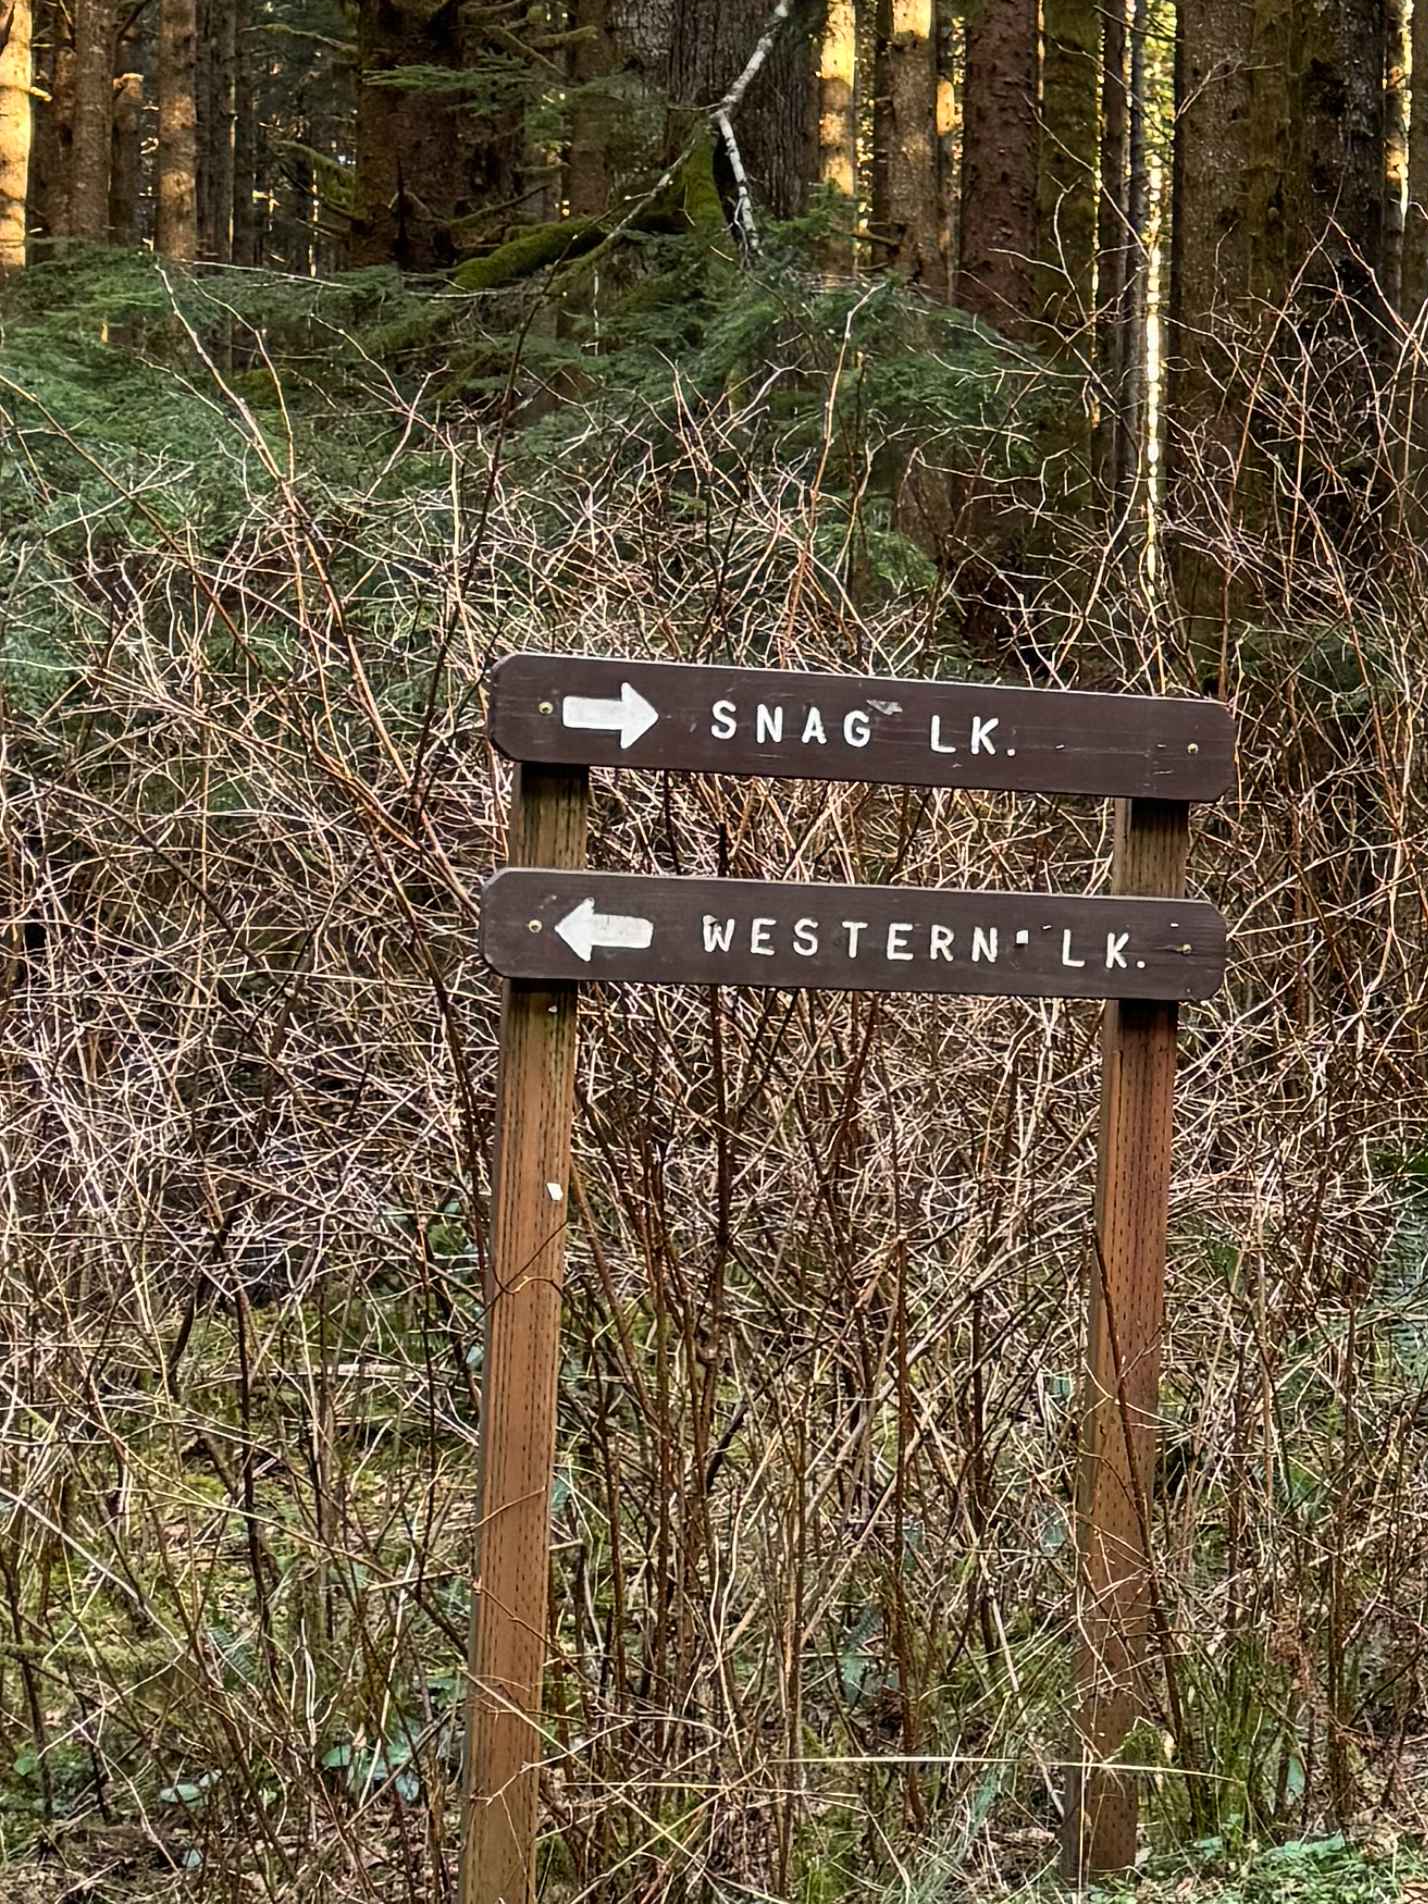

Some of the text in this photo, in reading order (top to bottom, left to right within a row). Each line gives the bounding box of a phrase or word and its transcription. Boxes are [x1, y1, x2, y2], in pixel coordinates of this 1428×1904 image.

[710, 699, 1017, 756] SNAG LK.
[703, 914, 1148, 969] WESTERN LK.
